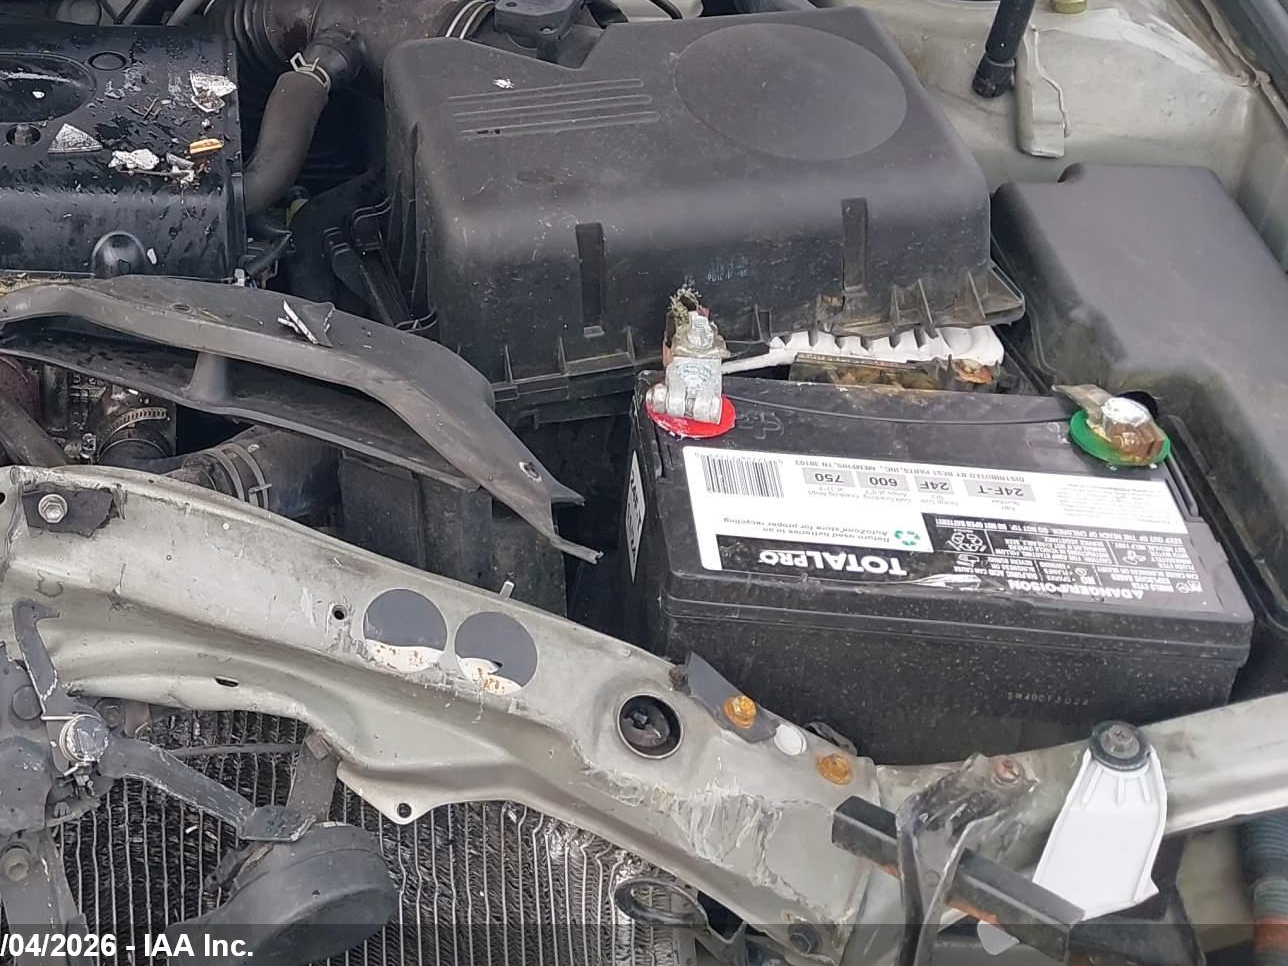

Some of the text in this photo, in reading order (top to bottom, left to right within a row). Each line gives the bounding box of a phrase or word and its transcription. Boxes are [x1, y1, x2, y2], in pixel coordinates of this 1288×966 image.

[813, 472, 843, 483] 750
[868, 476, 898, 487] 600
[968, 472, 1024, 482] DISTRIBUTED
[918, 480, 949, 491] 24F
[975, 484, 1024, 496] 24F-T
[723, 517, 764, 526] recycling
[767, 520, 797, 528] proper
[787, 529, 830, 537] batteries
[856, 534, 890, 542] Return
[758, 548, 907, 576] TOTALPRO
[952, 565, 973, 573] CAUSE
